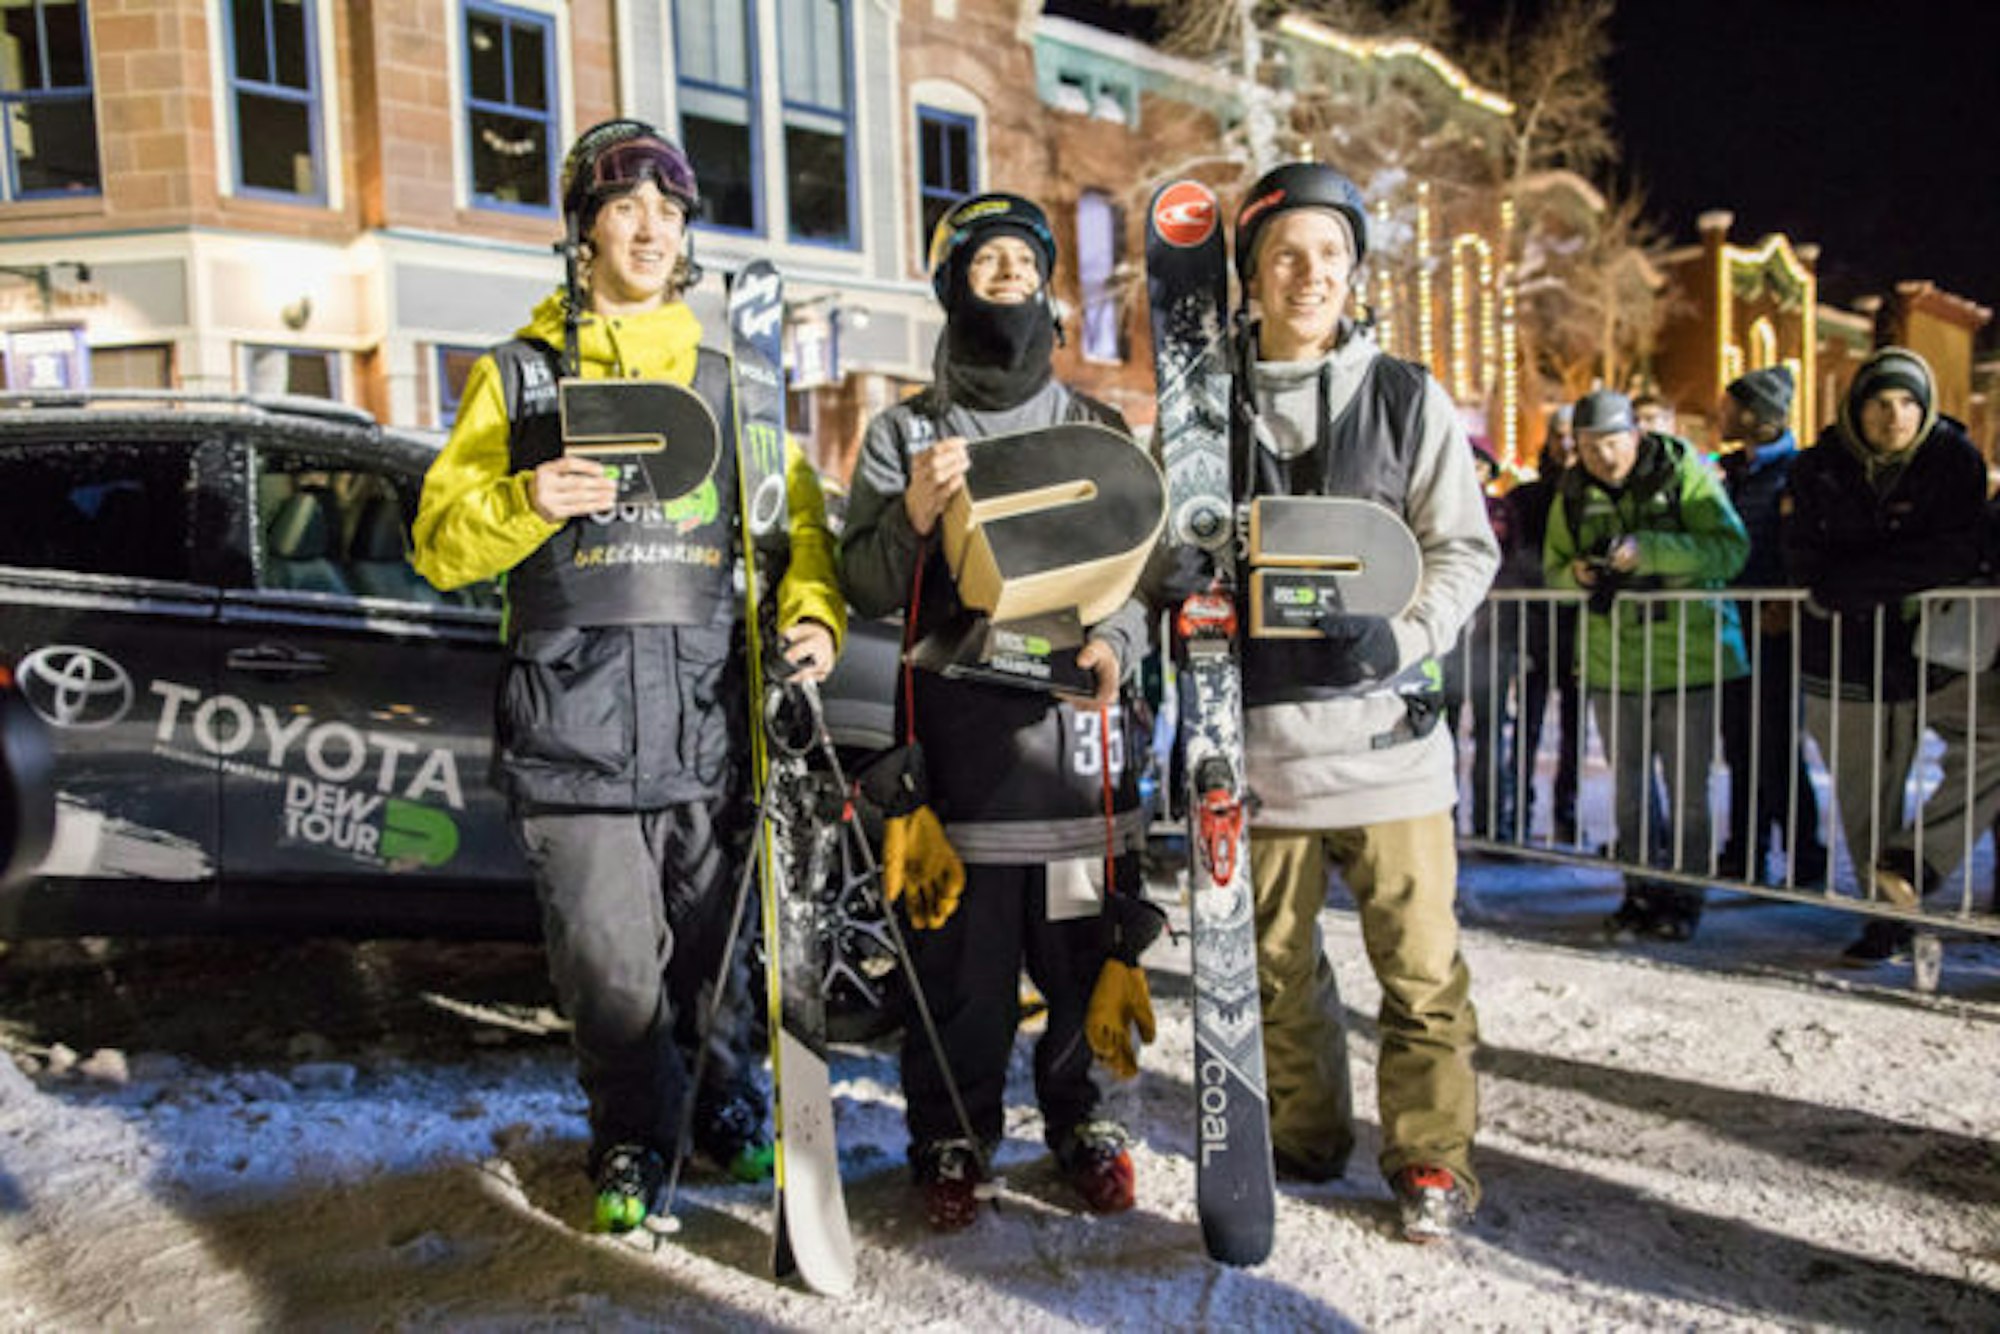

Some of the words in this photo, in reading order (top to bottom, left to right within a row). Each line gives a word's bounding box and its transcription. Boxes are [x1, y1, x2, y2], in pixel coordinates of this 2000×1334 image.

[151, 679, 465, 810] TOYOTA
[286, 775, 385, 823] DEW
[285, 808, 380, 854] TOUR
